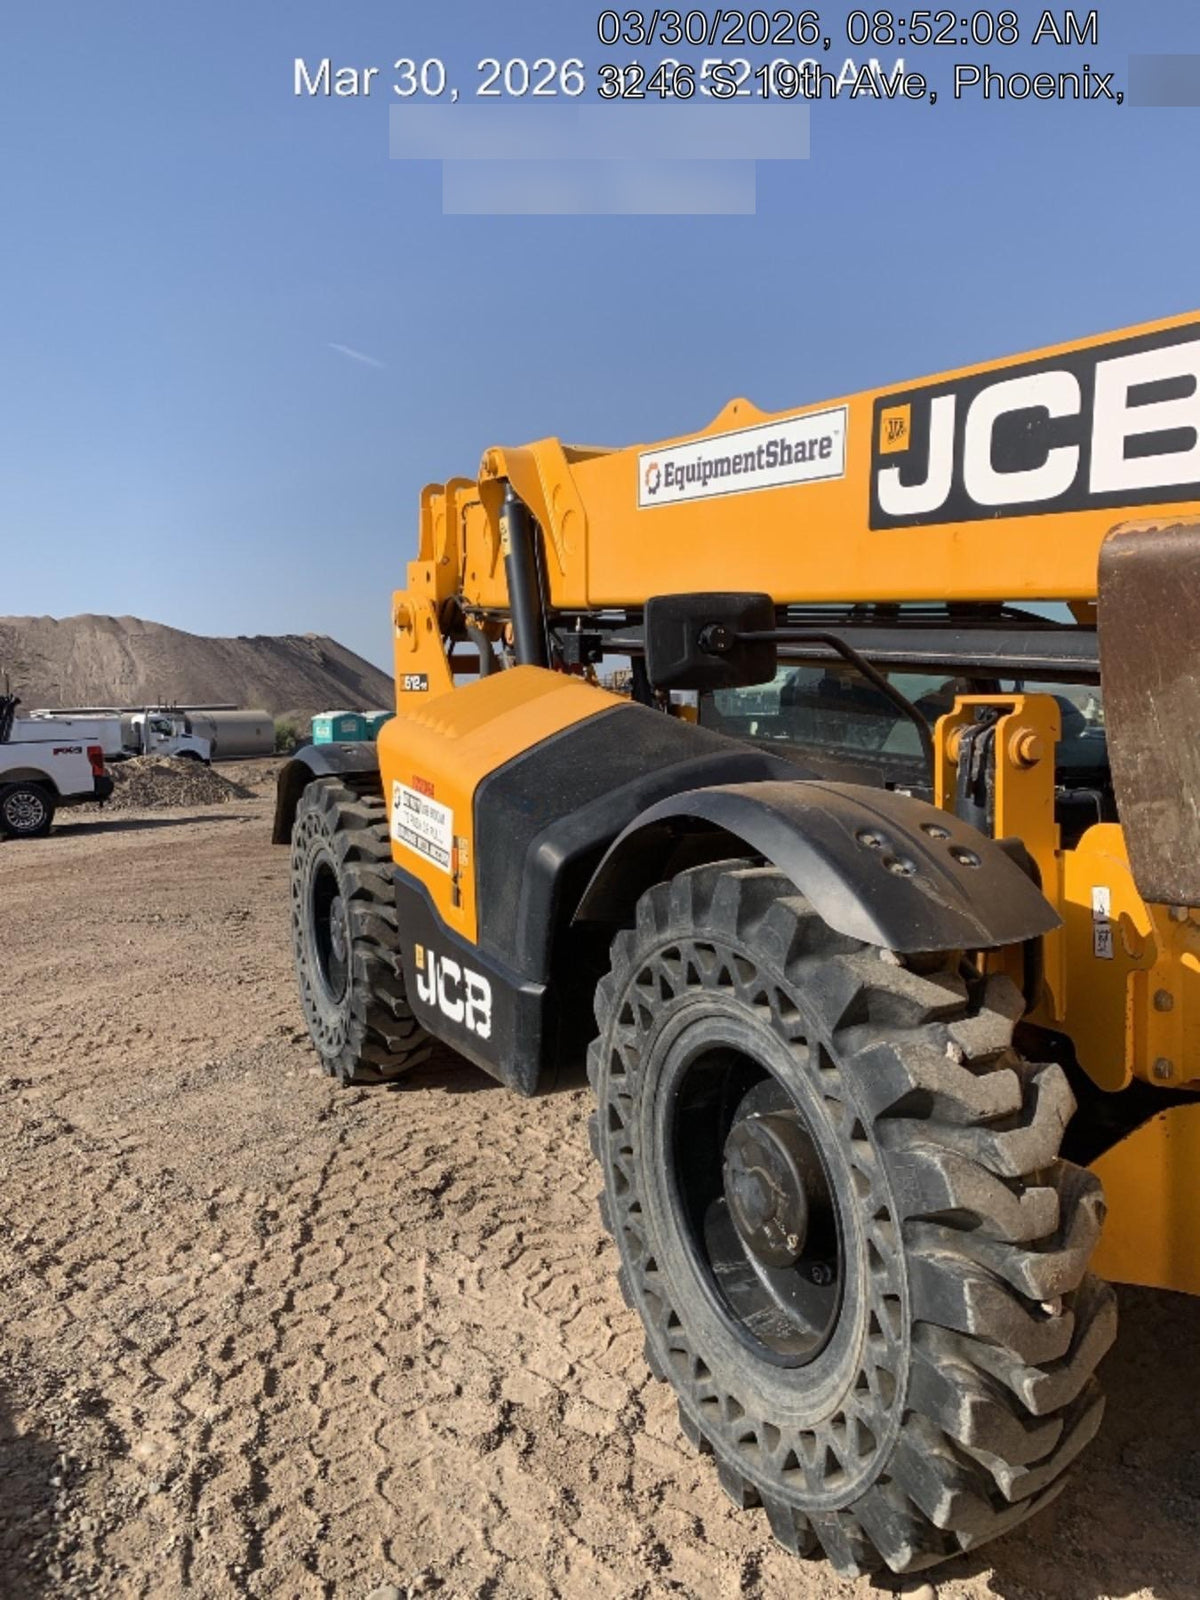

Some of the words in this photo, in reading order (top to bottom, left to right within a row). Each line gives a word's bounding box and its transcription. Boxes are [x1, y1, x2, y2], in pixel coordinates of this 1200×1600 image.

[663, 434, 833, 491] EquipmentShare
[877, 339, 1200, 516] JCB
[416, 949, 492, 1039] JCB
